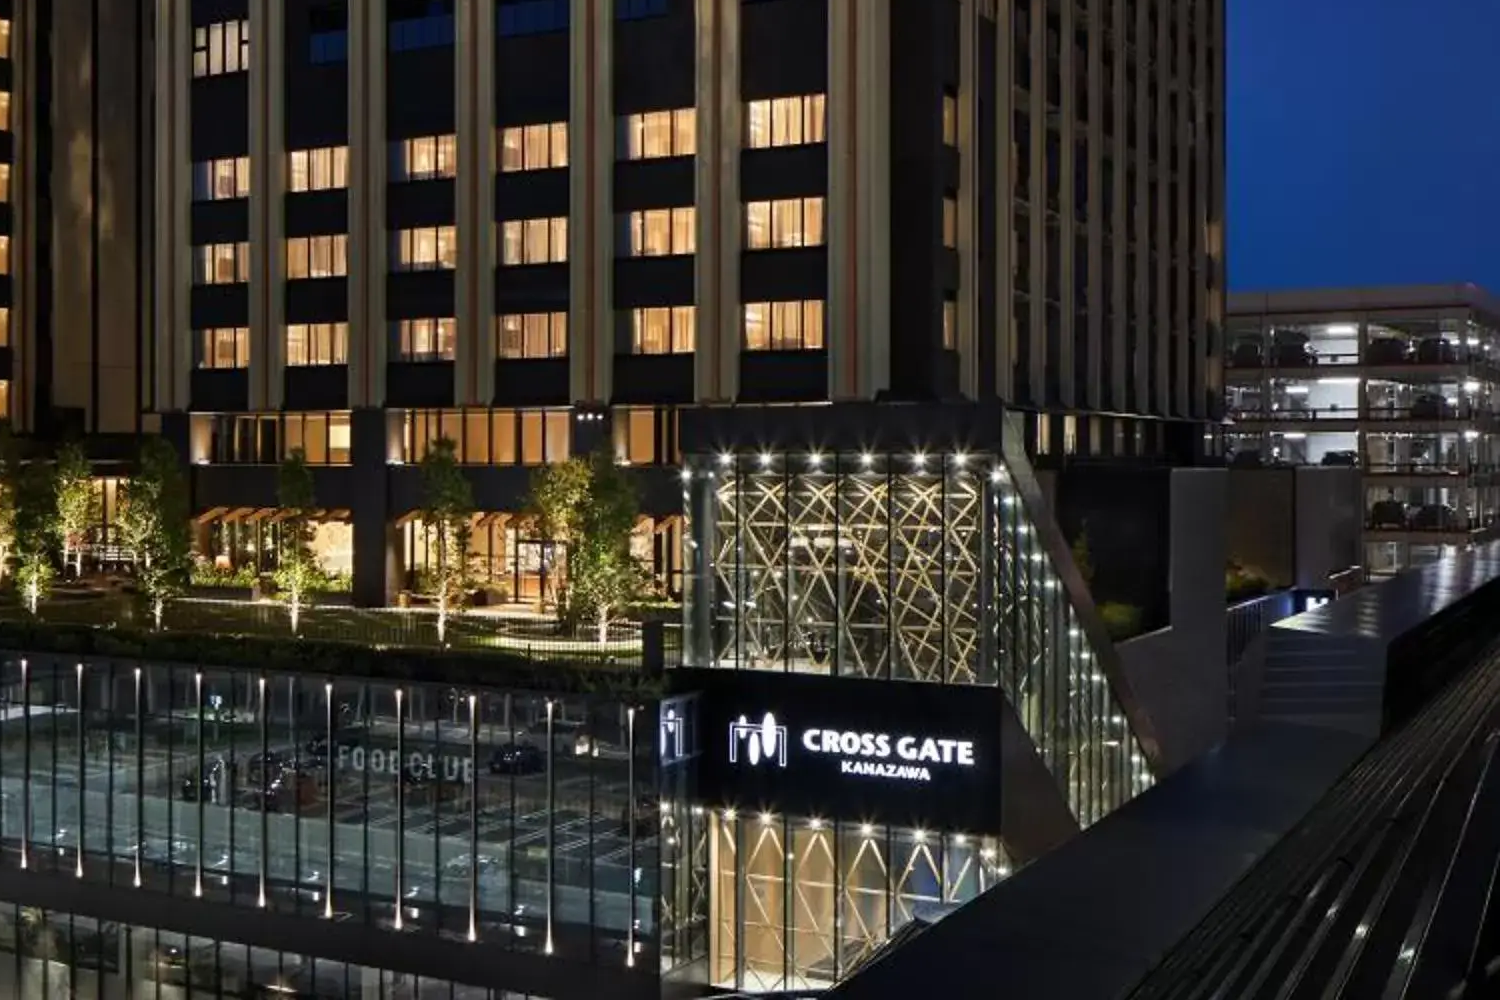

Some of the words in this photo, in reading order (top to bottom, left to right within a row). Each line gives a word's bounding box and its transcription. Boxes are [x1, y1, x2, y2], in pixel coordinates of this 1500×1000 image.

[802, 728, 891, 757] CROSS
[896, 735, 976, 766] GATE
[841, 760, 931, 781] KANAZAWA
